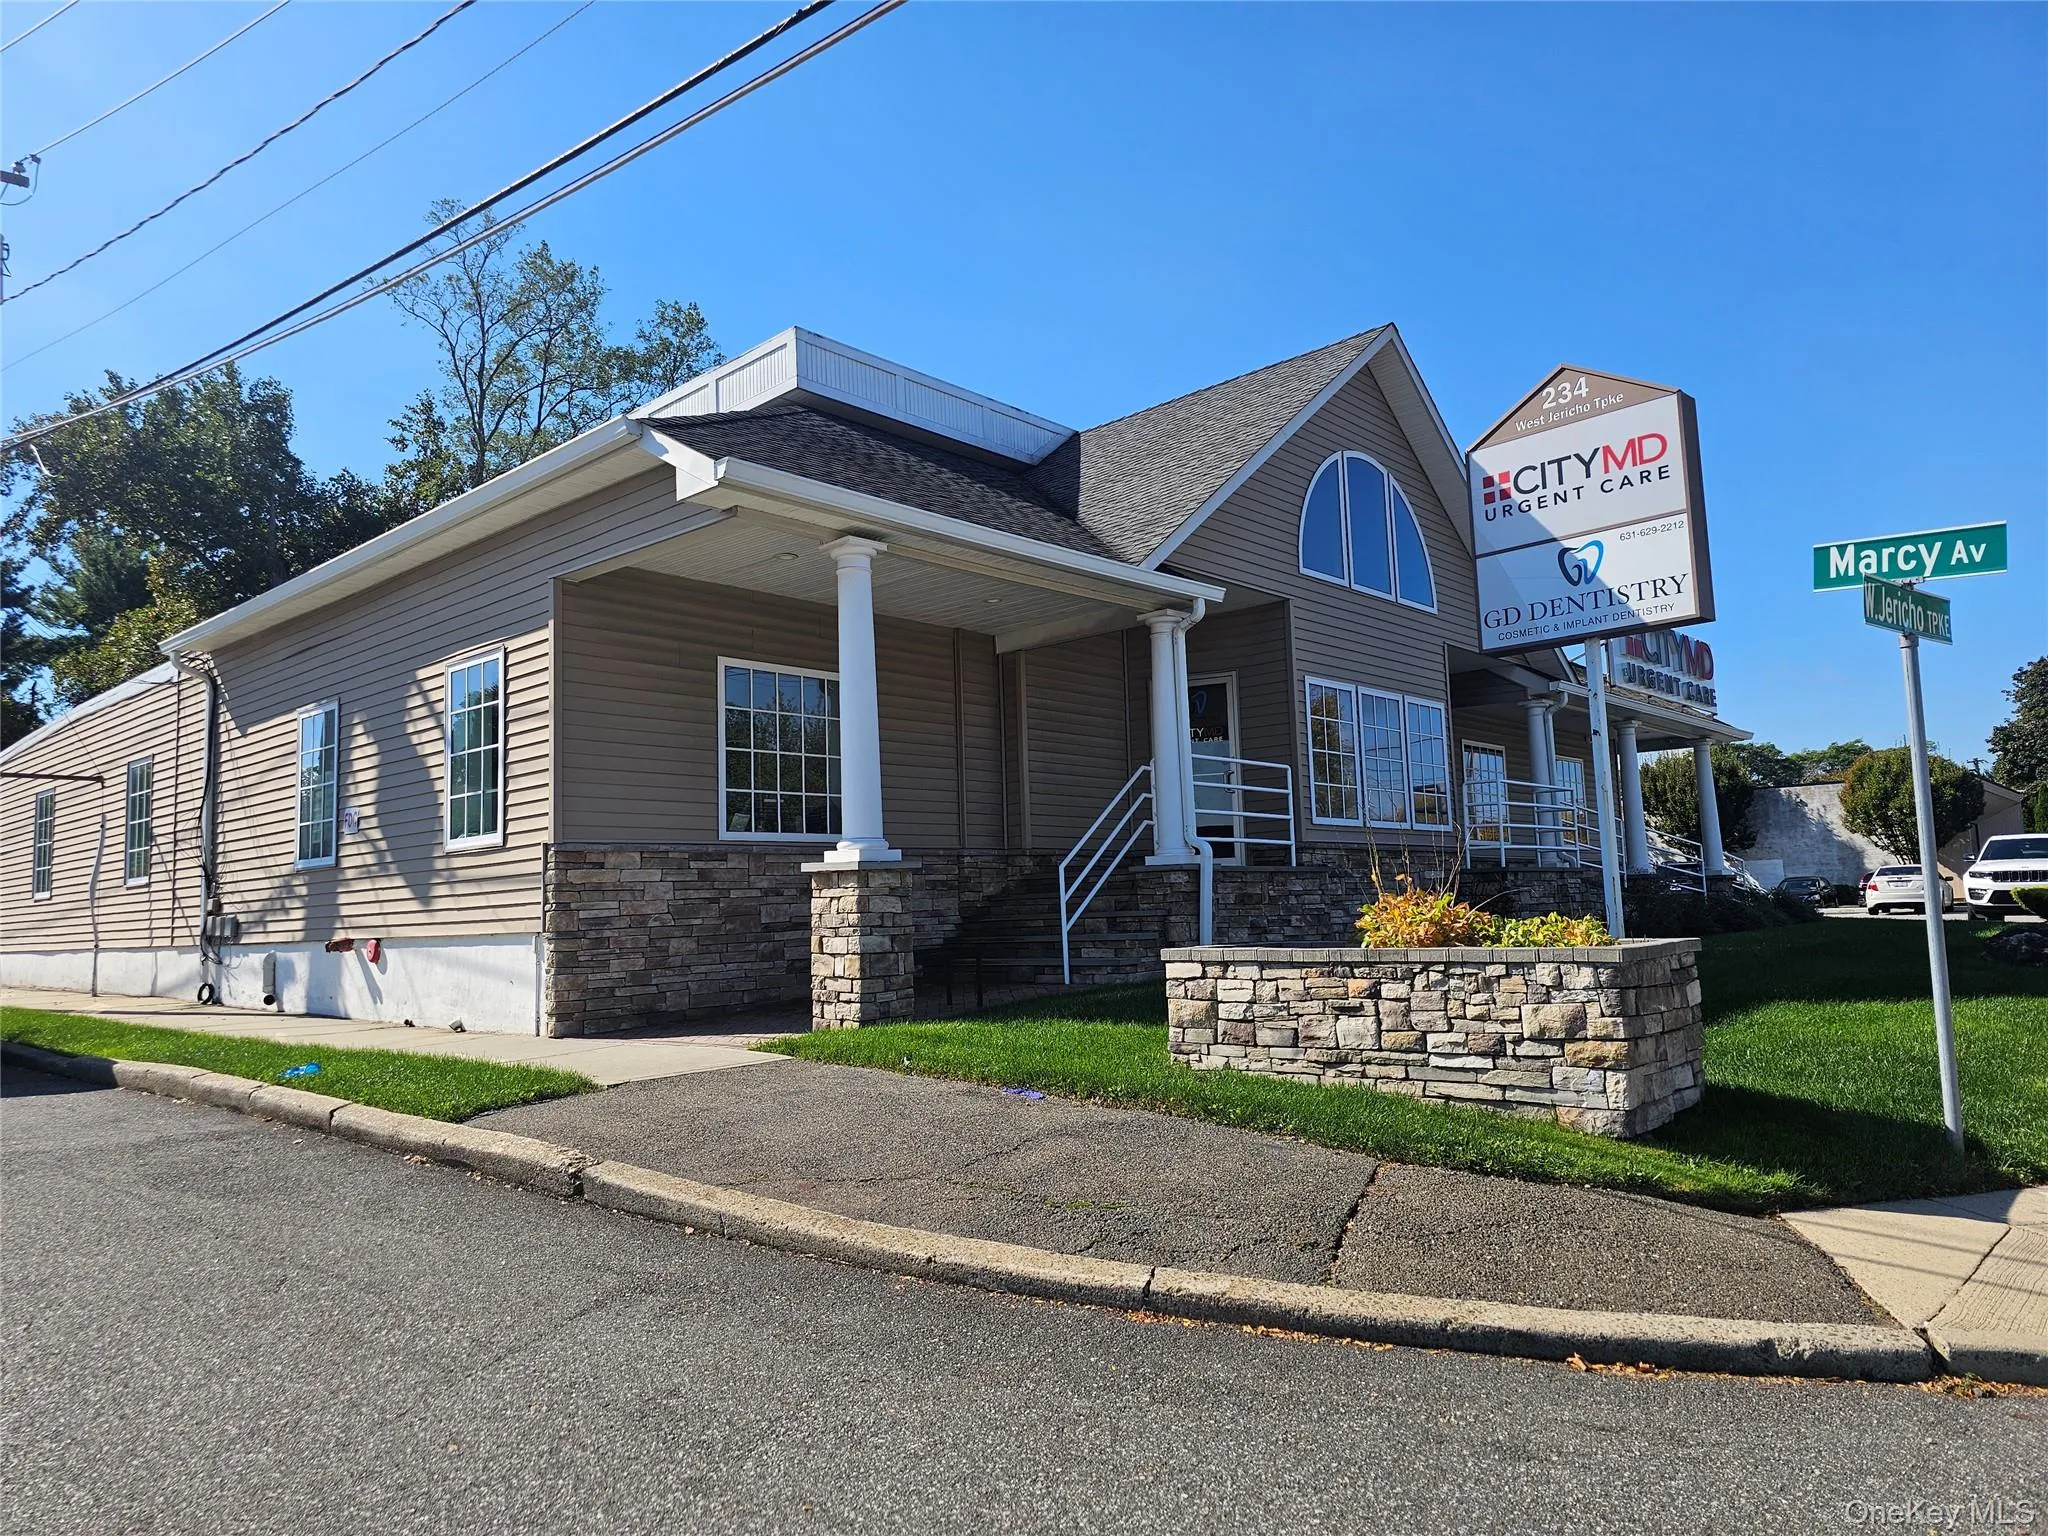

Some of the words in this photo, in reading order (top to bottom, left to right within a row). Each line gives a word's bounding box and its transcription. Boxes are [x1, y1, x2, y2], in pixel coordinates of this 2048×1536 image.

[1515, 415, 1545, 432] West
[1548, 402, 1590, 423] Jericho
[1594, 392, 1624, 410] Tpke
[1541, 376, 1589, 409] 234
[1512, 432, 1668, 496] CITYMD
[1485, 485, 1585, 522] URGENT
[1599, 464, 1670, 494] CARE
[1619, 520, 1684, 541] 631-629-2212
[1829, 541, 1942, 578] Marcy
[1950, 540, 1986, 565] Av
[1484, 607, 1521, 629] GD
[1529, 573, 1689, 622] DENTISTRY
[1498, 624, 1550, 641] COSMETIC
[1553, 623, 1560, 632] &
[1563, 614, 1608, 631] IMPLANT
[1612, 603, 1675, 622] DENTISTRY
[1926, 610, 1950, 637] TPKE
[1623, 661, 1680, 697] URGENT
[1681, 681, 1717, 707] CARE
